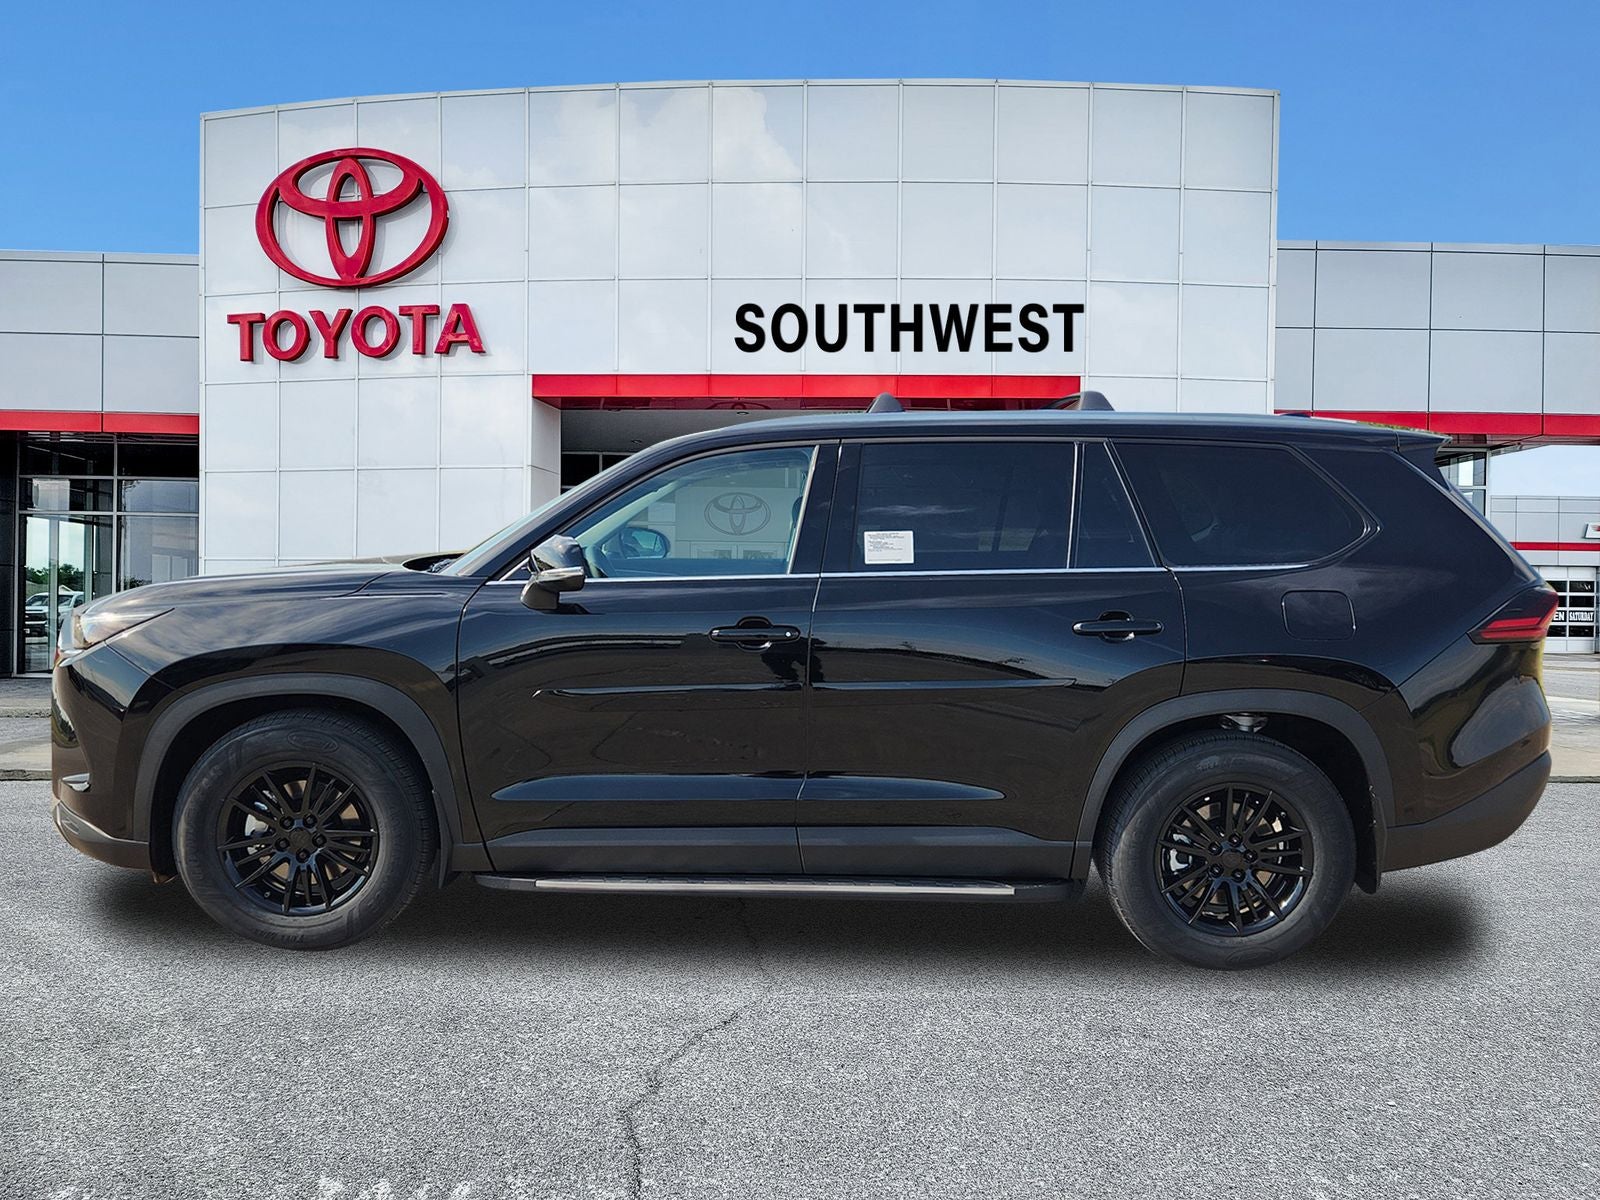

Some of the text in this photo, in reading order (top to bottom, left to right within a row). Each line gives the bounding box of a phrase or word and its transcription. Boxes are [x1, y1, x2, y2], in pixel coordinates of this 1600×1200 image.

[227, 303, 486, 362] TOYOTA
[734, 303, 1084, 352] SOUTHWEST
[1569, 611, 1594, 621] SATURDAY
